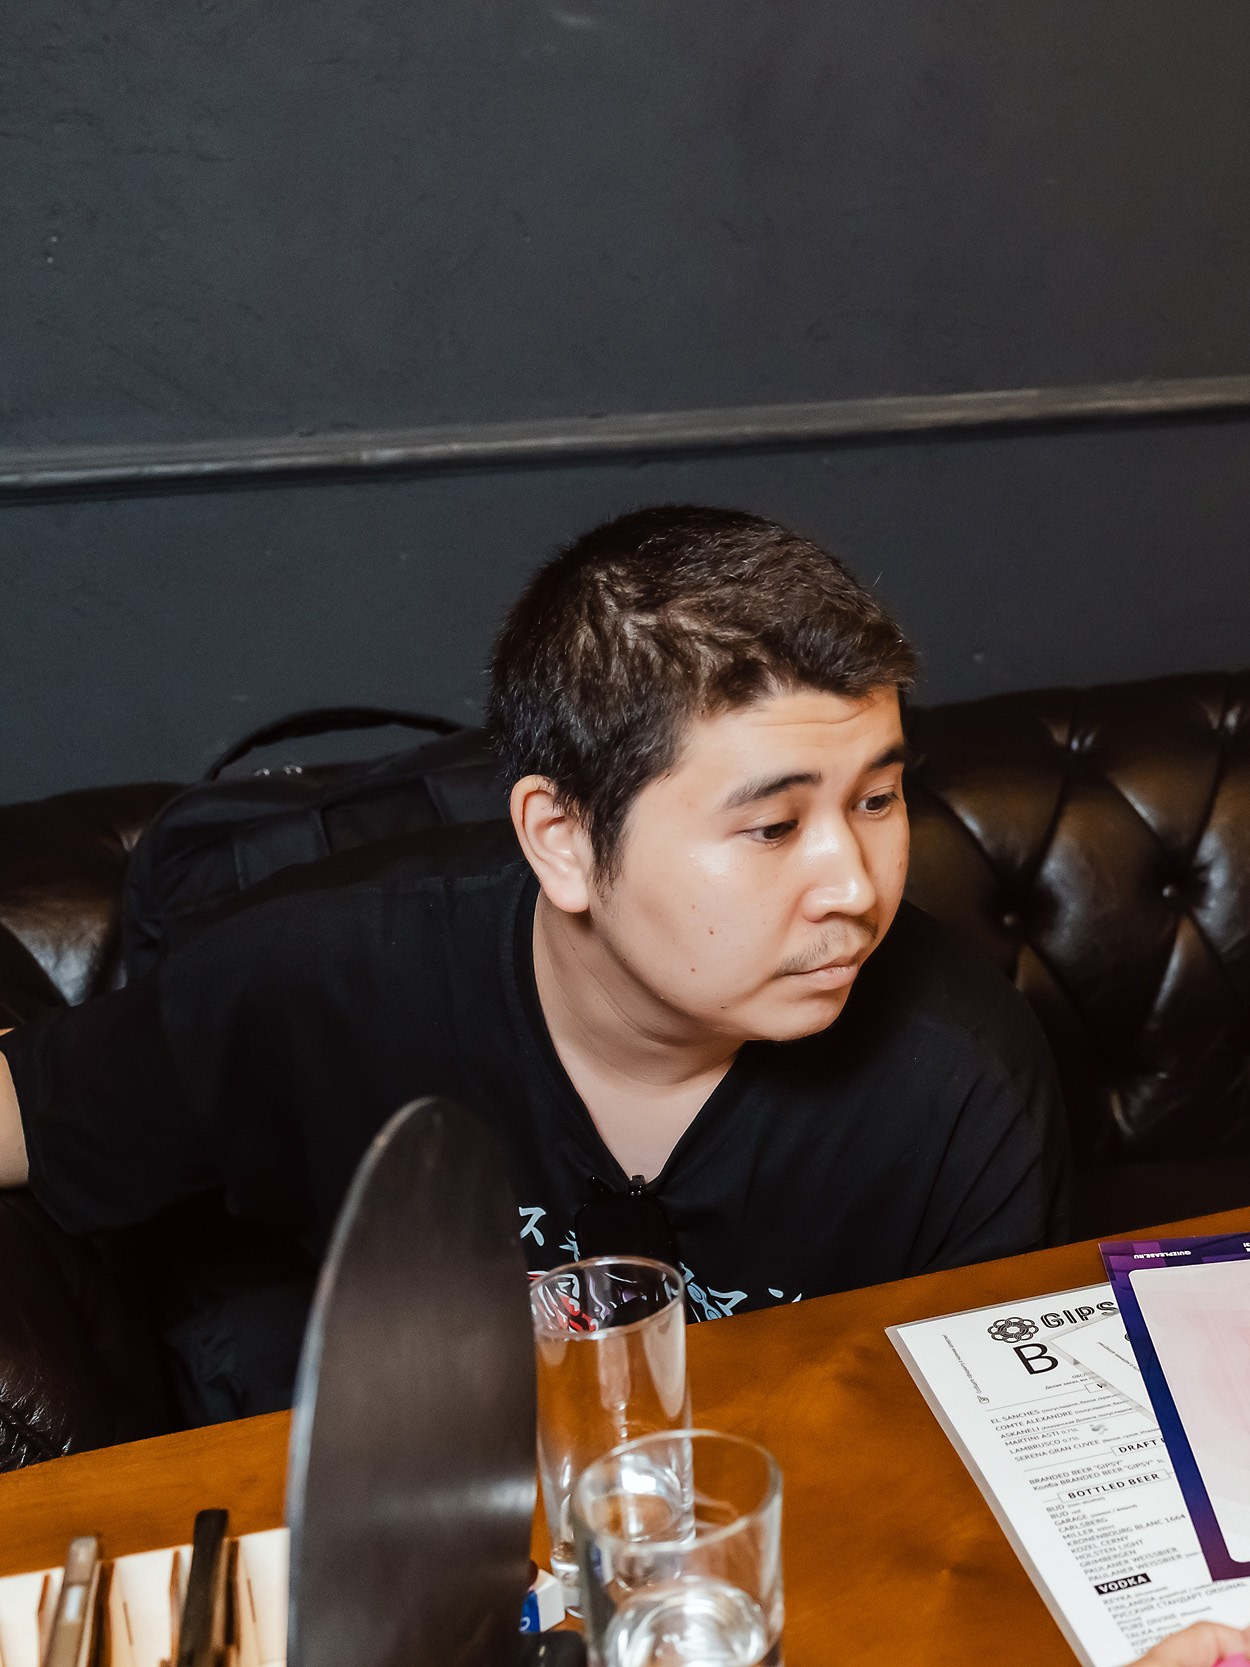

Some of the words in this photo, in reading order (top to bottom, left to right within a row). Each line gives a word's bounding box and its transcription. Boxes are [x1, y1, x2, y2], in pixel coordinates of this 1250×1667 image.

[1133, 1250, 1192, 1260] QUIZPLEASE.RU
[995, 1421, 1023, 1431] COMTE
[1026, 1410, 1074, 1425] ALEXANDRE
[1002, 1409, 1040, 1422] SANCHES
[1000, 1426, 1041, 1439] ASKANELI
[1005, 1435, 1040, 1447] MARTINI
[1041, 1430, 1060, 1440] ASTI
[1009, 1439, 1061, 1454] LAMBRUSCO
[1014, 1451, 1048, 1462] SERENA
[1048, 1446, 1072, 1456] GRAN
[1073, 1439, 1100, 1450] CUVEE
[1118, 1439, 1157, 1453] DRAFT
[1029, 1468, 1070, 1485] BRANDED
[1071, 1465, 1093, 1476] BEER
[1060, 1472, 1100, 1485] BRANDED
[1101, 1467, 1123, 1478] BEER
[1068, 1481, 1125, 1499] BOTTLED
[1128, 1473, 1160, 1485] BEER
[1045, 1504, 1065, 1513] BUD
[1050, 1510, 1069, 1519] BUD
[1054, 1514, 1088, 1526] GARAGE
[1058, 1518, 1108, 1533] CARLSBERG
[1062, 1528, 1094, 1540] MILLER
[1066, 1527, 1134, 1546] KRONENBOURG
[1134, 1519, 1163, 1531] BLANC
[1164, 1514, 1186, 1524] 1664
[1071, 1543, 1098, 1553] KOZEL
[1075, 1546, 1116, 1560] HOLSTEN
[1118, 1540, 1144, 1550] LIGHT
[1079, 1550, 1137, 1568] GRIMBERGEN
[1084, 1560, 1131, 1575] PAULANER
[1132, 1547, 1178, 1563] WEISSBIER
[1088, 1567, 1135, 1582] PAULANER
[1137, 1554, 1182, 1570] WEISSBIER
[1098, 1575, 1148, 1593] VODKA
